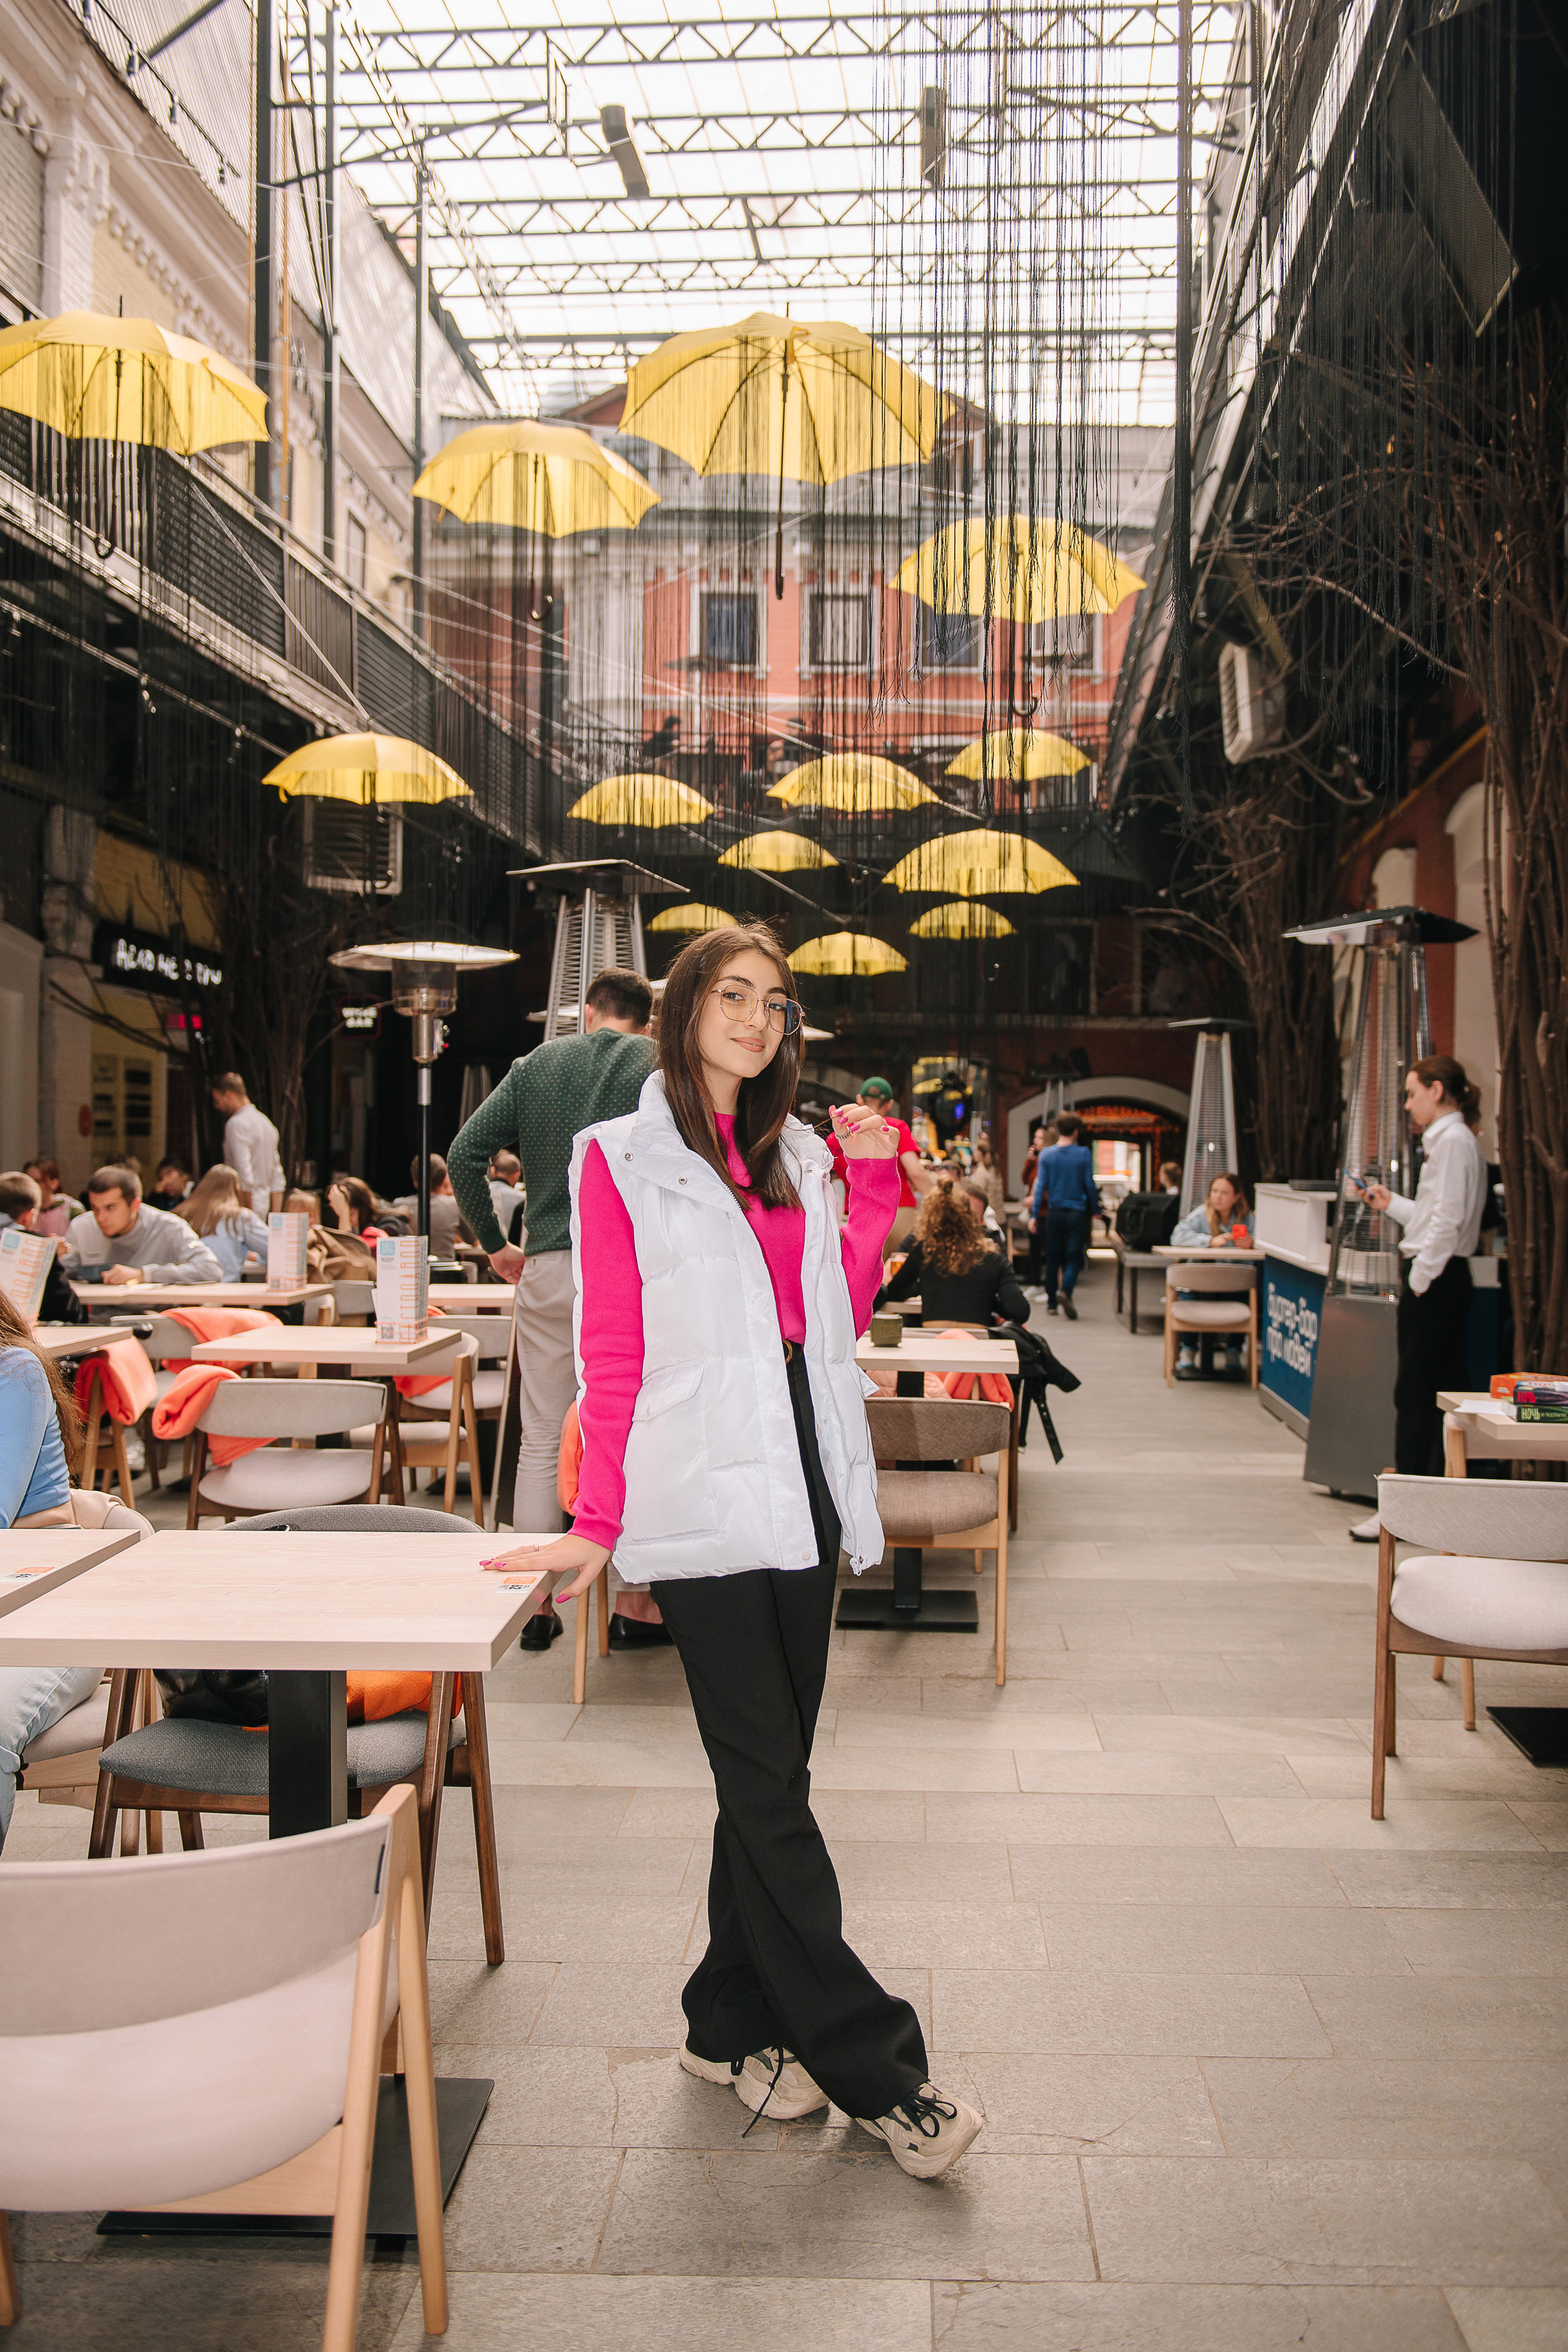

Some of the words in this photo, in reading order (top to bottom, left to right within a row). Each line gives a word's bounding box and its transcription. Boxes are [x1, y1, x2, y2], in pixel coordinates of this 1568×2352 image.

[1267, 1325, 1283, 1363] про
[1517, 1390, 1536, 1403] НОЧЬ
[1521, 1408, 1540, 1420] НОЧЬ
